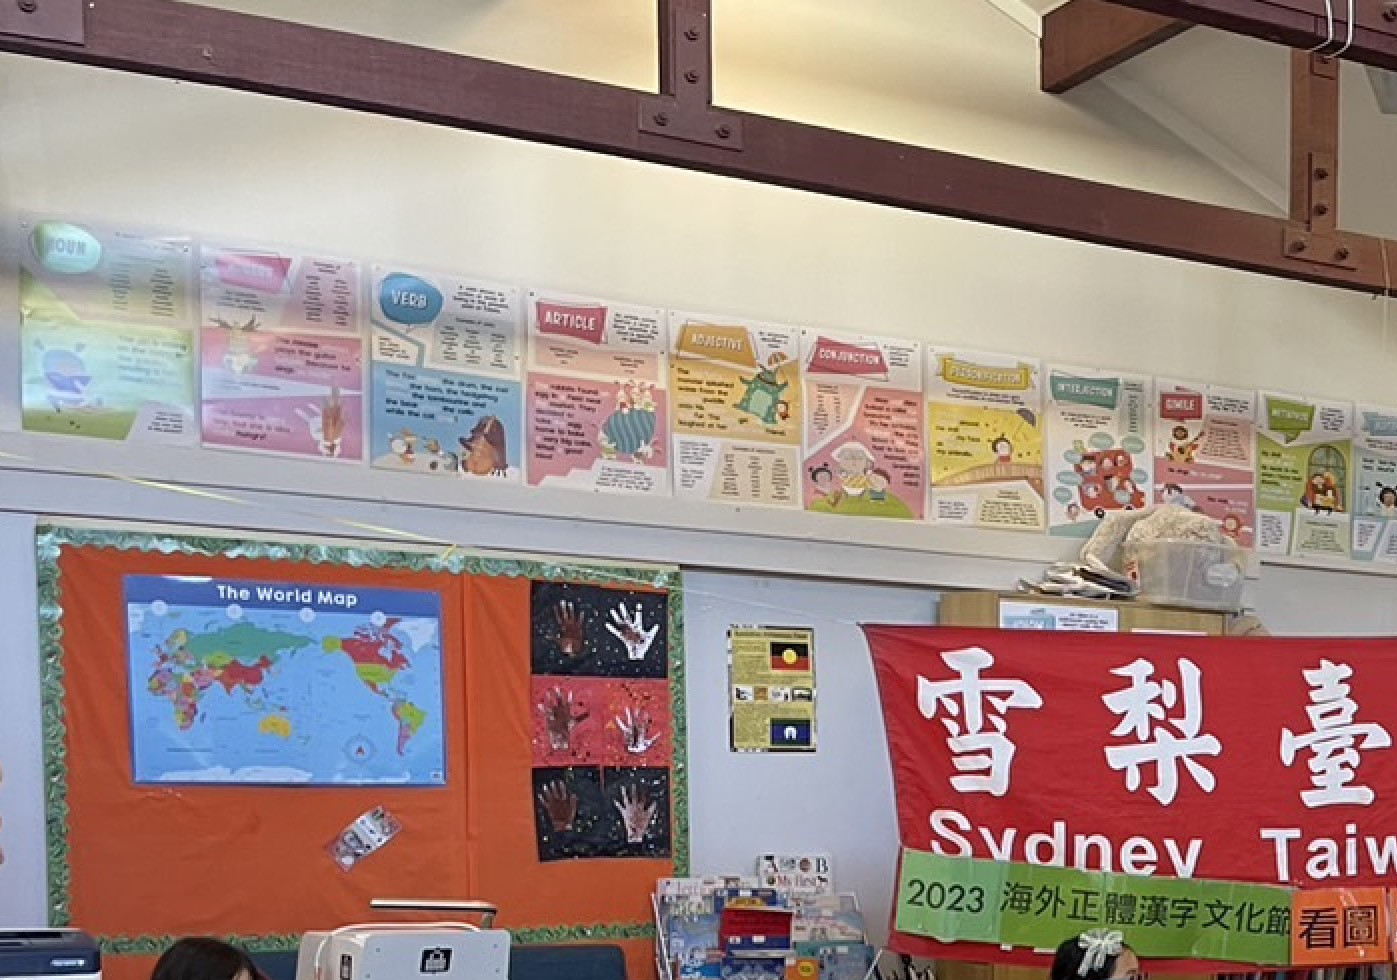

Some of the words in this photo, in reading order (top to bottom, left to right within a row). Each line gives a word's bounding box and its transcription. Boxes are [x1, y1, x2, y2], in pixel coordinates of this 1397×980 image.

[391, 290, 427, 308] VERB
[545, 308, 597, 331] ARTICLE
[690, 331, 744, 352] ADJECTIVE
[819, 347, 880, 367] CONJUNCTION
[1165, 398, 1195, 412] SIMILE
[217, 585, 250, 601] The
[256, 587, 311, 604] World
[317, 591, 357, 608] Map
[931, 810, 1203, 877] Sydney
[906, 879, 986, 913] 2023
[1000, 881, 1291, 938] 海外正體漢字文化節
